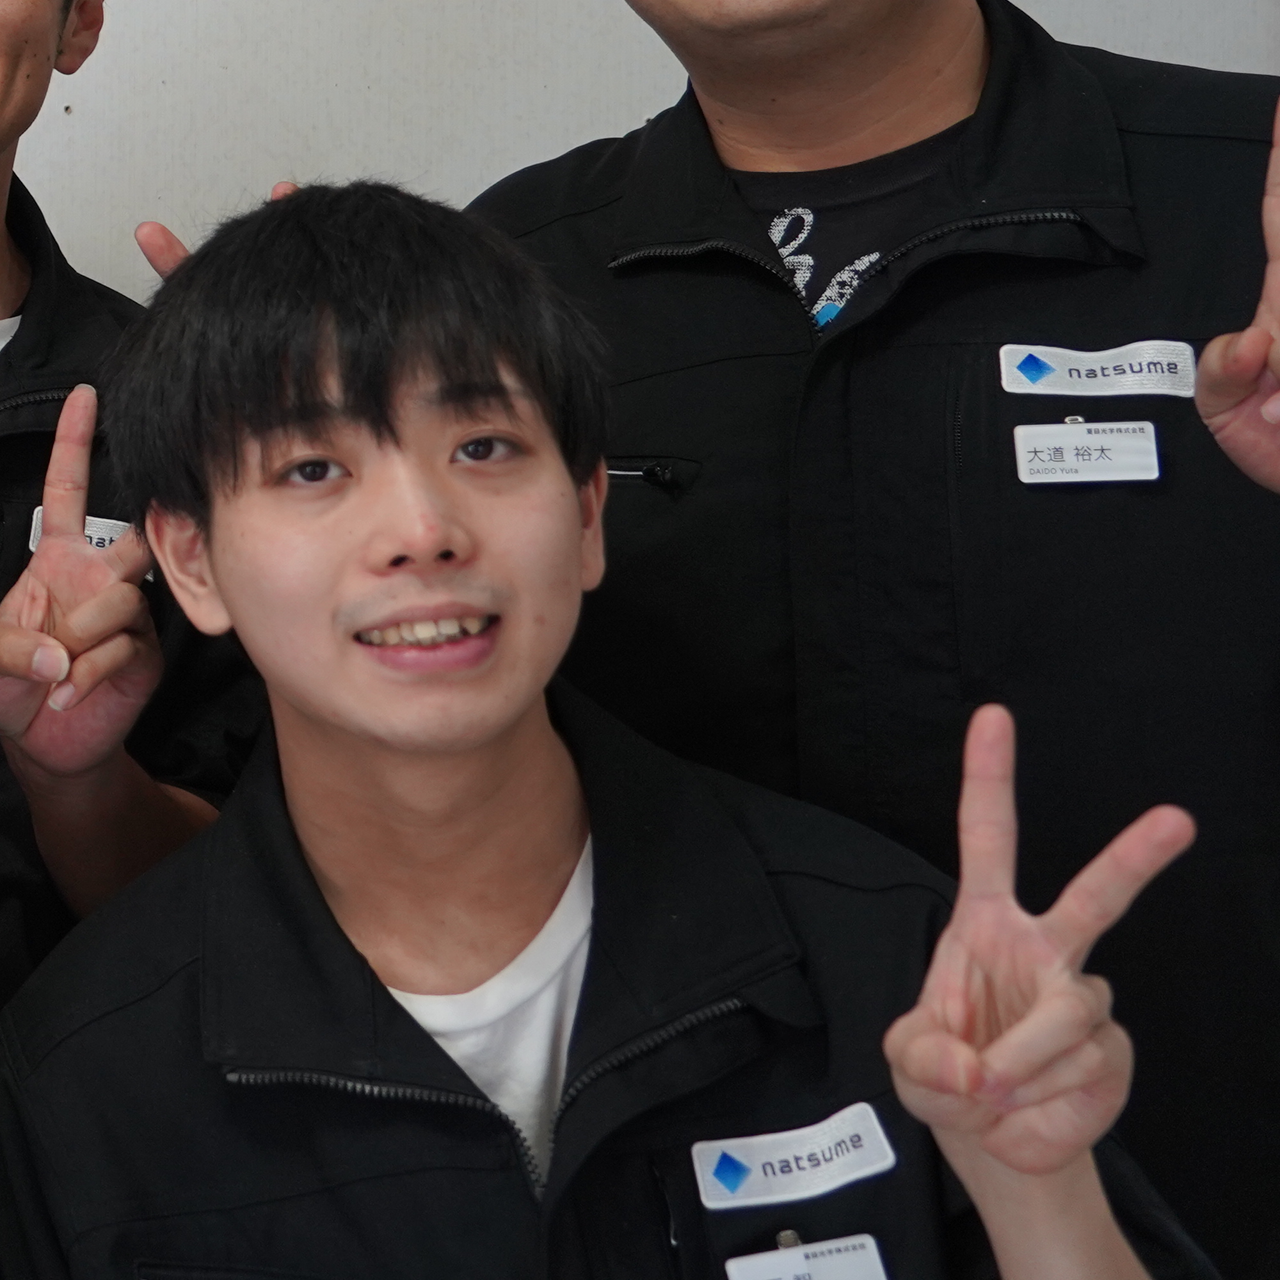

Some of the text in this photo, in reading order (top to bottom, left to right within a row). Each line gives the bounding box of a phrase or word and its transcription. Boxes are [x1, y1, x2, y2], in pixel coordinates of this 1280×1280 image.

[1068, 361, 1179, 379] natsume
[1027, 445, 1113, 463] 大道 裕太
[1029, 467, 1079, 475] DAIDO Yuta
[761, 1132, 864, 1178] natsume
